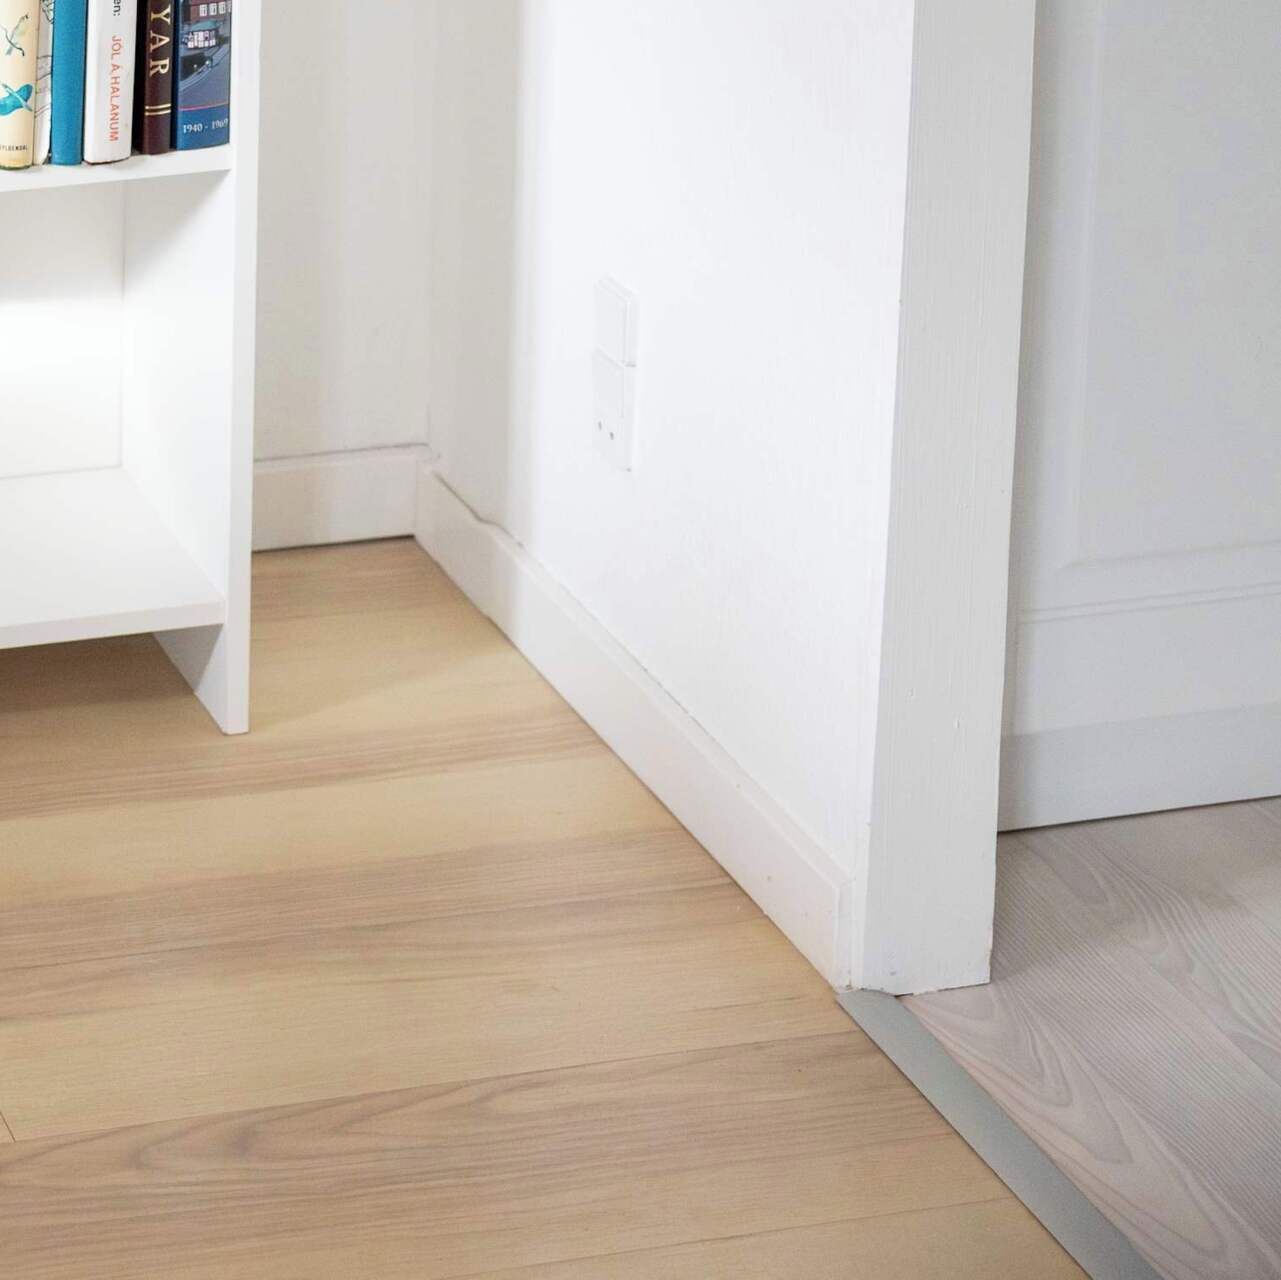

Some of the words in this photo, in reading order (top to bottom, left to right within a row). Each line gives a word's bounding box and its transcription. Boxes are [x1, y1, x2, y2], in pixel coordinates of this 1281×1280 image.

[111, 35, 124, 59] JÓL
[109, 73, 121, 142] HALANUM
[182, 123, 203, 134] 1940
